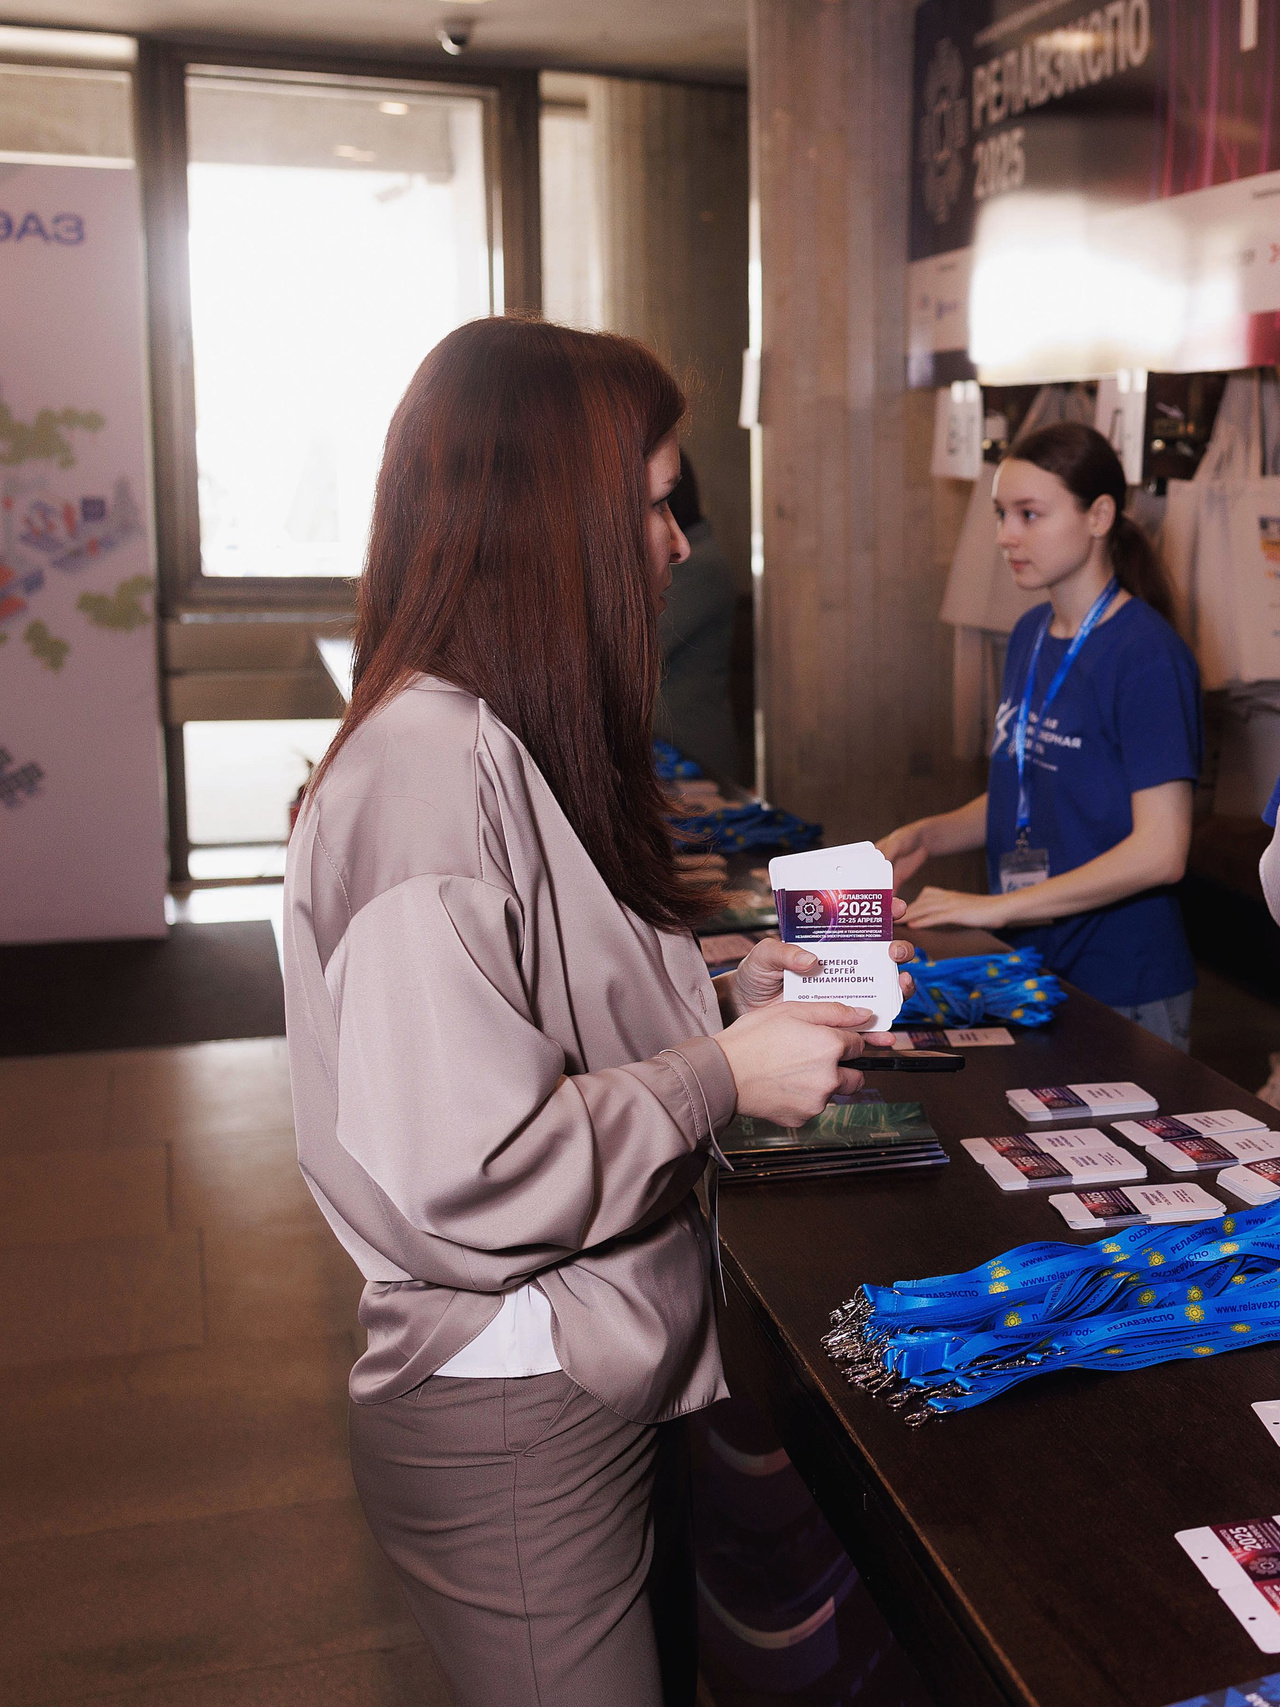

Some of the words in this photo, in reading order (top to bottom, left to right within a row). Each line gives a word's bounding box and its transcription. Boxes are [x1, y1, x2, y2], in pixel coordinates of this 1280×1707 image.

[838, 901, 882, 916] 2025
[802, 976, 874, 984] ВЕНИАМИНОВИЧ
[1170, 1226, 1218, 1254] РЕЛАВЭКСПО
[1107, 1313, 1175, 1332] РЕЛАВЭКСПО
[1227, 1526, 1263, 1551] 2025
